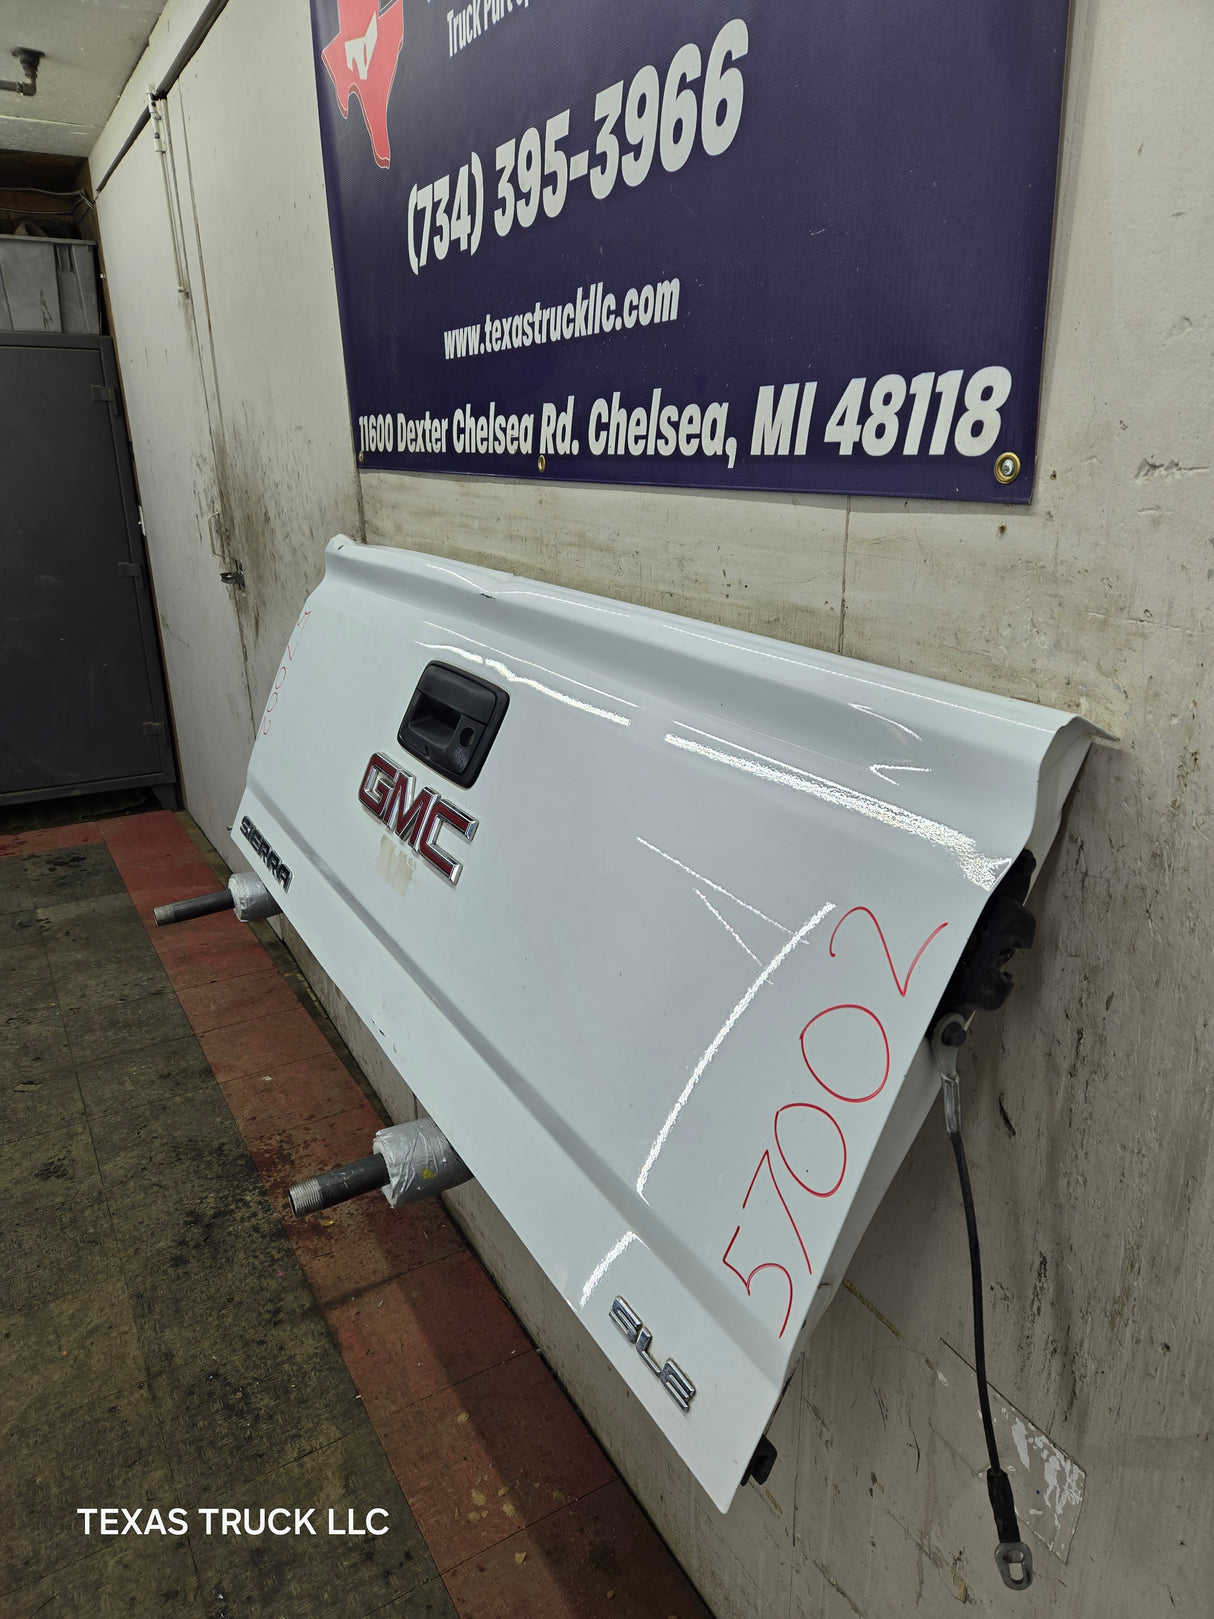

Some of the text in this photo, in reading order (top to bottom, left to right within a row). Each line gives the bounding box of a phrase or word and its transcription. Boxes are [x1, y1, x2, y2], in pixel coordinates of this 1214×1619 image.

[447, 0, 482, 58] Truck
[407, 18, 749, 275] (734) 395-3966
[443, 277, 681, 360] www.texastruckllc.com
[358, 365, 1012, 469] 11600 Dexter Chelsea Rd. Chelsea, MI 48118
[240, 815, 294, 893] SIERRA
[358, 752, 480, 887] GMC
[723, 906, 948, 1338] 57002
[609, 1295, 696, 1413] SLE
